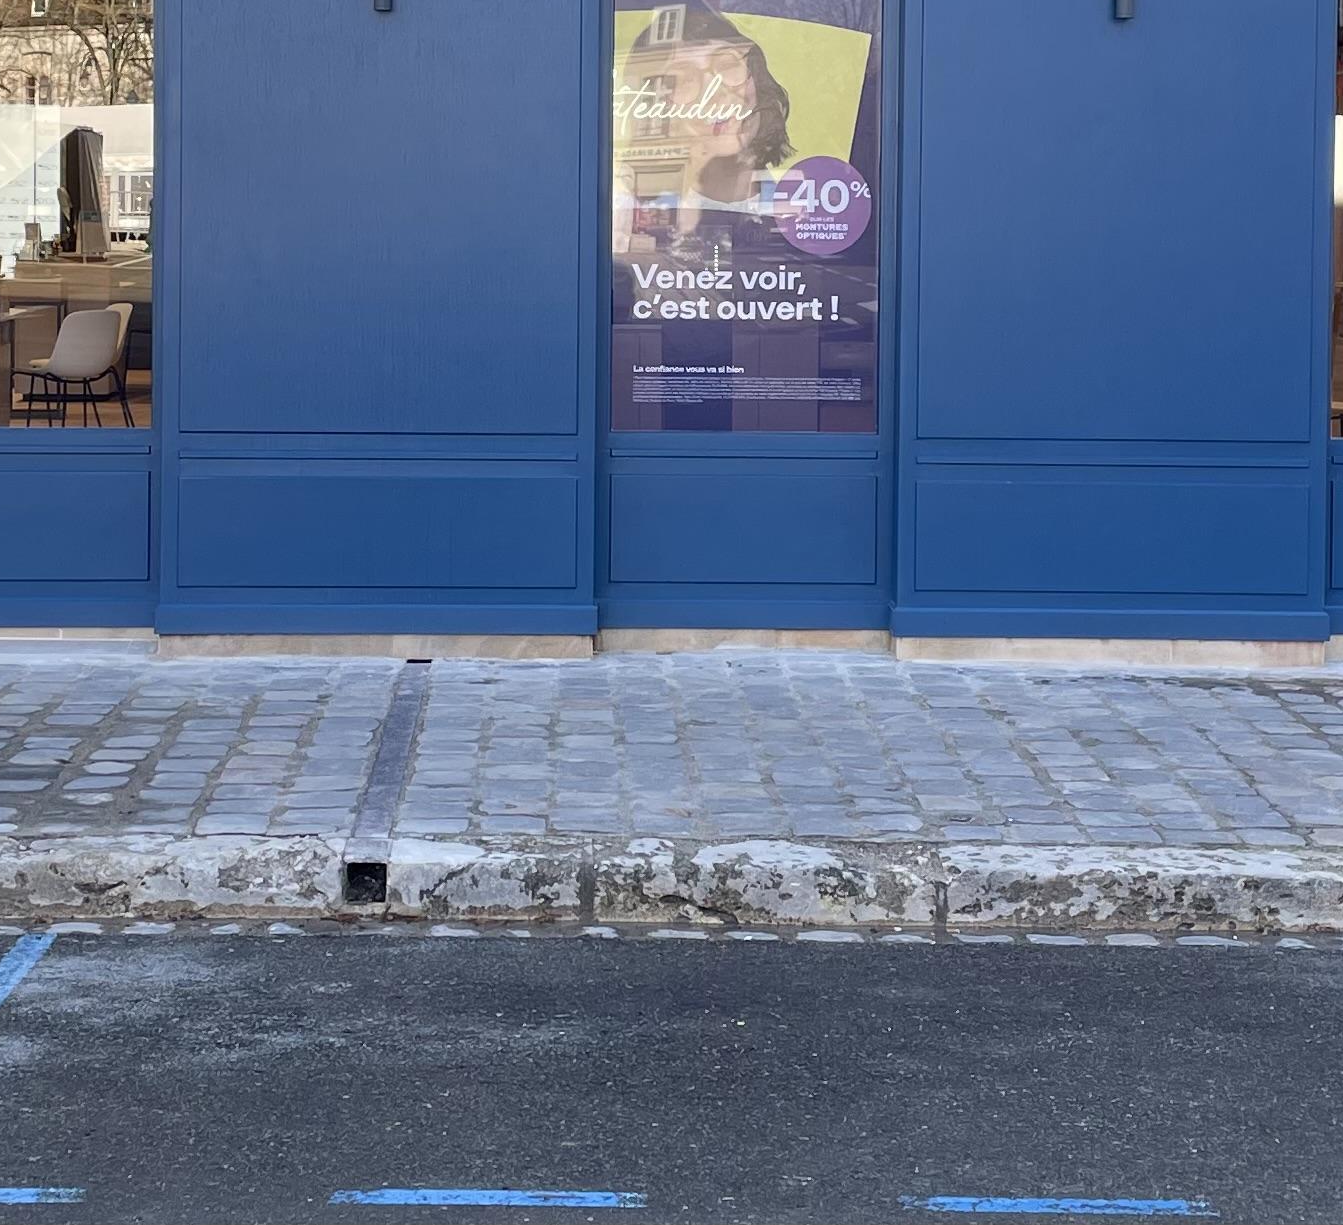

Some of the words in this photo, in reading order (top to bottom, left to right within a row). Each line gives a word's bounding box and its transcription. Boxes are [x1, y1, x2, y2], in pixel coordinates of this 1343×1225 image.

[773, 179, 872, 214] -40%
[795, 223, 849, 231] MONTURES
[632, 264, 733, 289] Venez
[740, 265, 806, 295] voir,
[633, 294, 710, 319] c'est
[717, 297, 823, 320] ouvert
[830, 296, 840, 321] !
[633, 364, 644, 373] La
[645, 365, 684, 374] confiance
[726, 365, 745, 374] bien
